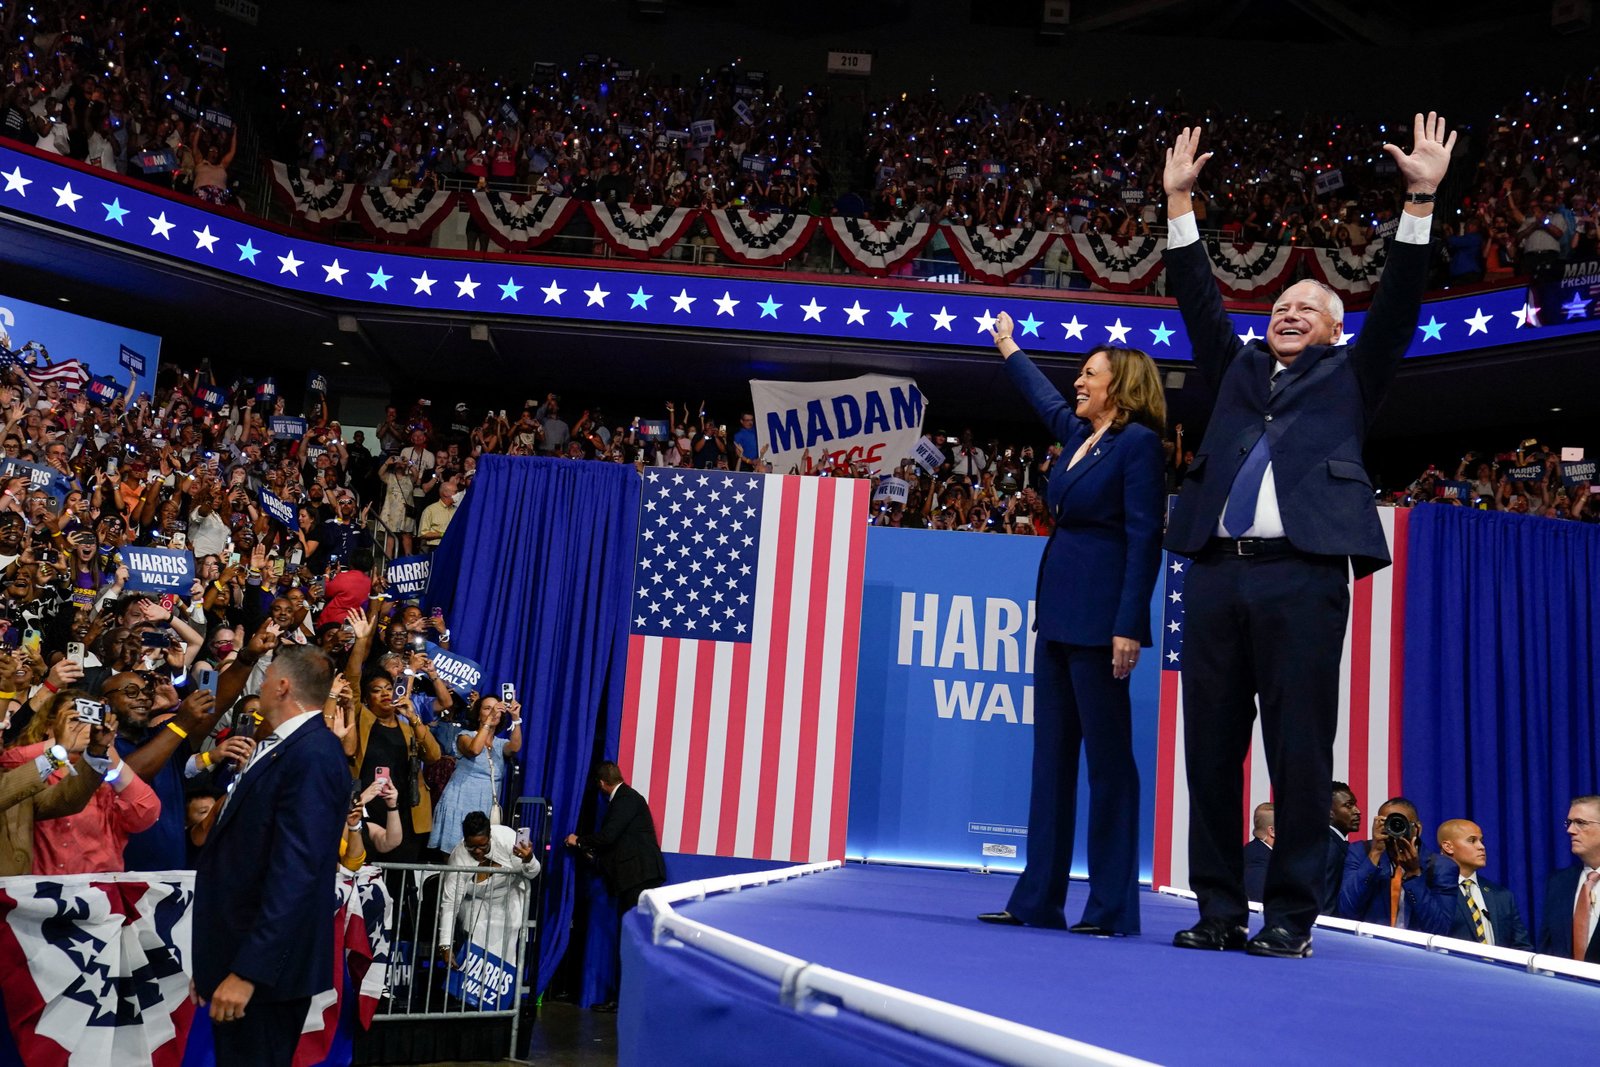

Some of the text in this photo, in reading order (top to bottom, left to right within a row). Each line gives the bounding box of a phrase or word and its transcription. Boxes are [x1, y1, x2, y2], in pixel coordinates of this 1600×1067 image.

[240, 2, 257, 18] 210
[841, 55, 859, 67] 210
[766, 384, 922, 455] MADAM
[273, 423, 303, 435] WE WIN
[916, 444, 928, 458] WE
[6, 462, 51, 486] HRIS
[1508, 465, 1541, 475] HARRIS
[1564, 463, 1596, 477] HARRIS
[1571, 474, 1593, 483] WALZ
[878, 485, 889, 495] WE
[889, 486, 905, 497] WIN
[262, 492, 293, 519] HARRIS
[269, 506, 290, 524] WALZ
[129, 552, 188, 575] HARRIS
[387, 560, 430, 584] HARRIS
[141, 572, 180, 587] WALZ
[396, 580, 426, 594] WALZ
[432, 653, 481, 686] HARRIS
[437, 668, 468, 690] WALZ
[458, 952, 514, 996] HARRIS
[461, 979, 498, 1006] WALZ
